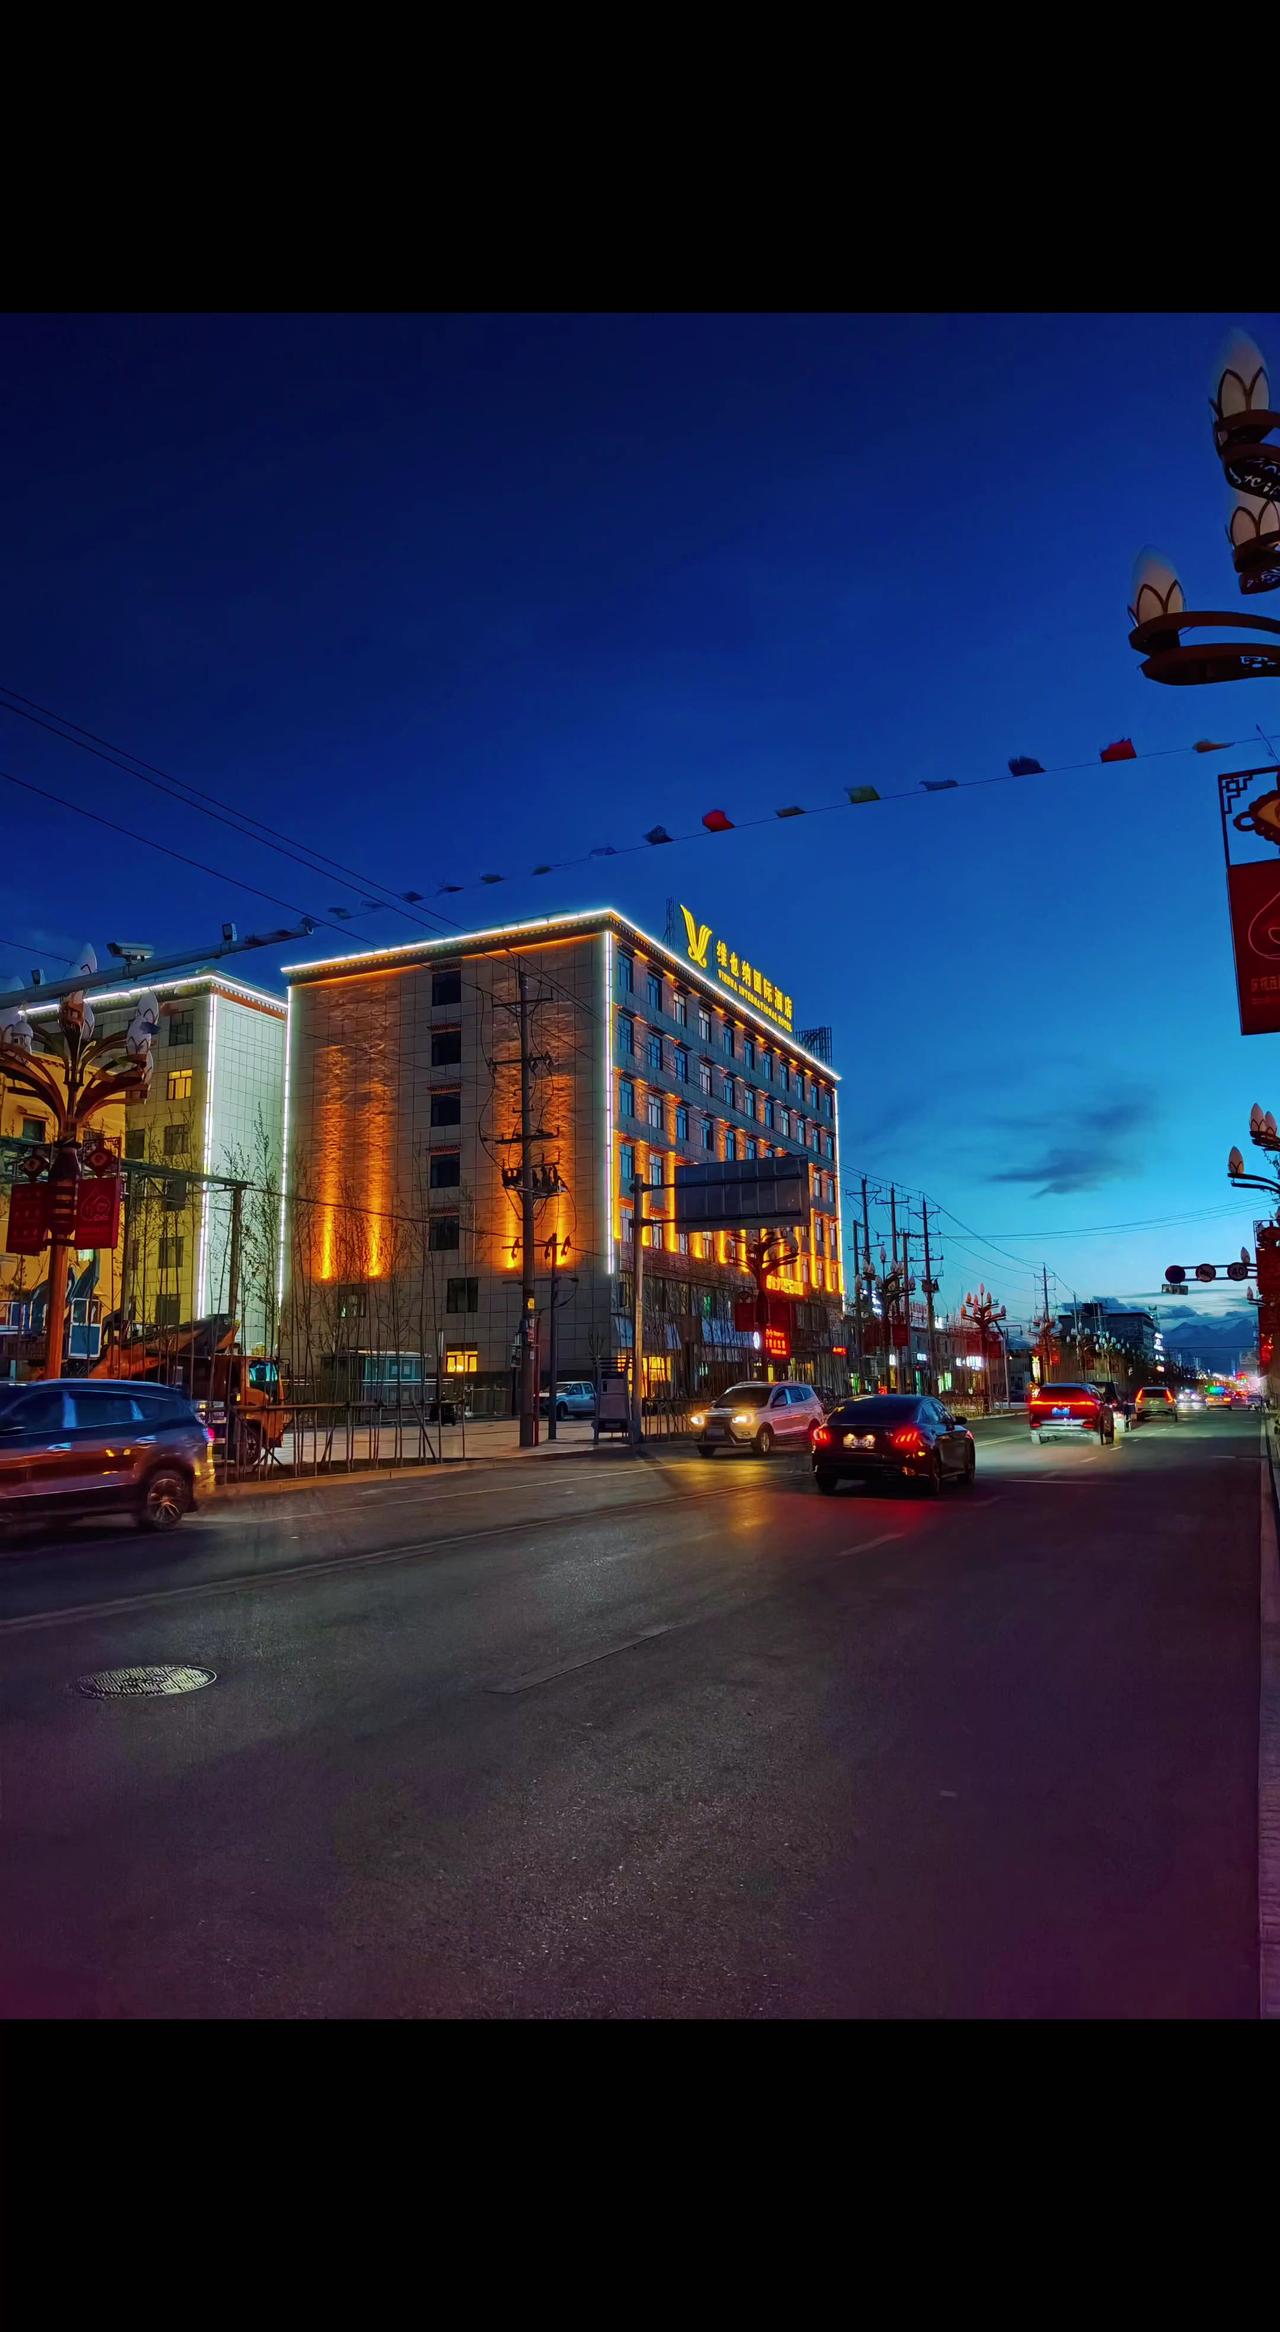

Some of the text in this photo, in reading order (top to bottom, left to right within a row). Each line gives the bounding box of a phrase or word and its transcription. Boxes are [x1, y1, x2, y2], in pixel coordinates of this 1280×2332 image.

[716, 940, 792, 1020] 维也纳国际酒店
